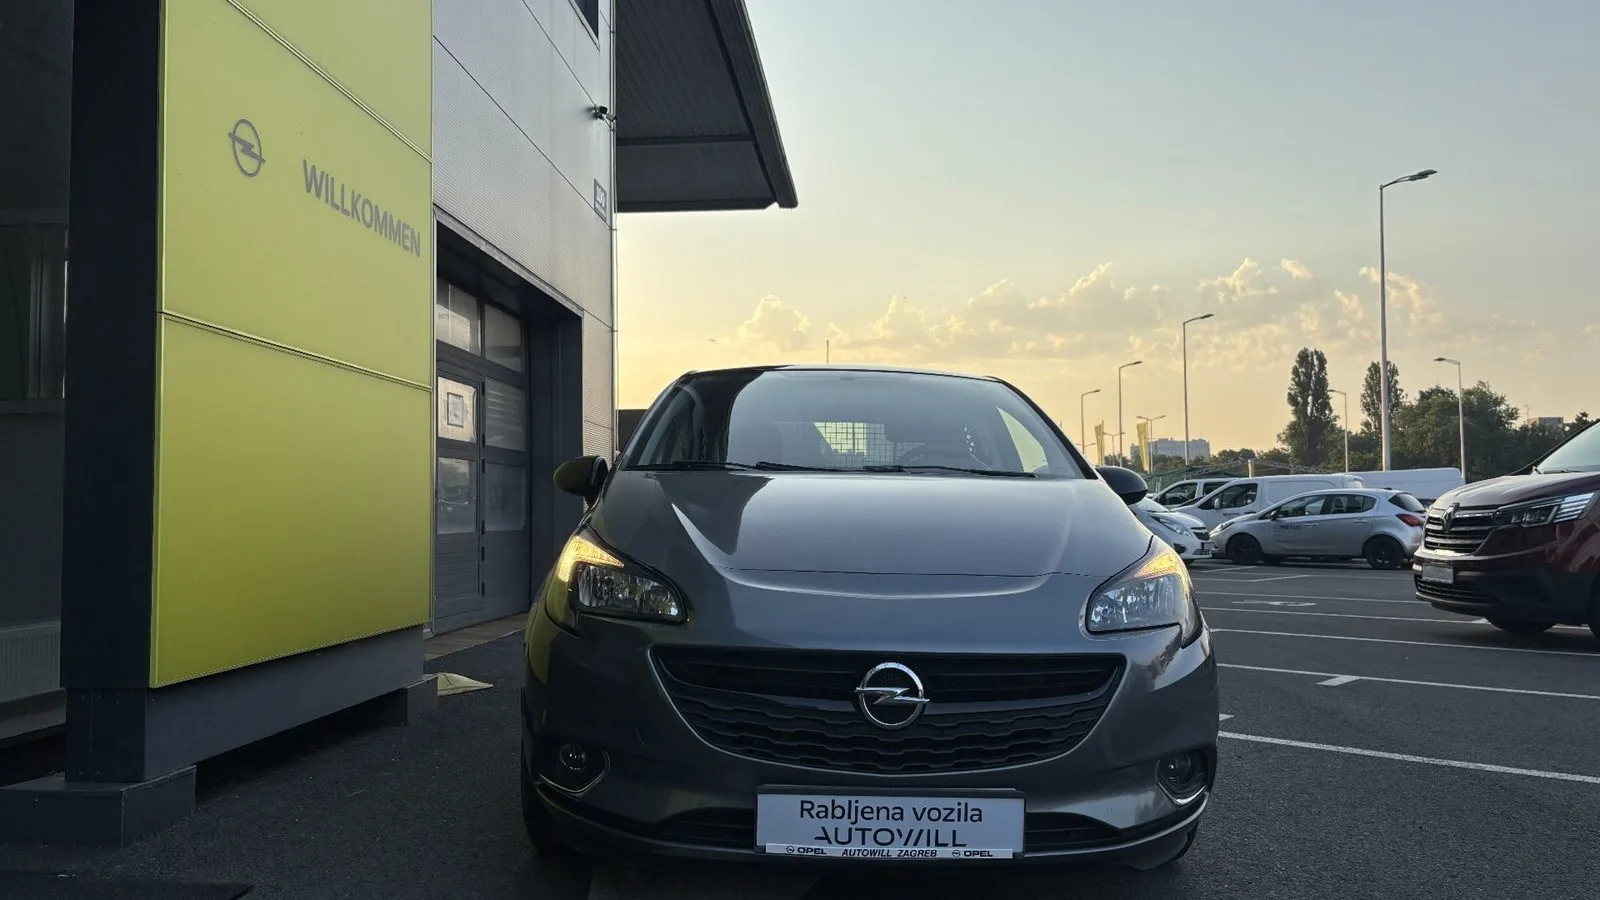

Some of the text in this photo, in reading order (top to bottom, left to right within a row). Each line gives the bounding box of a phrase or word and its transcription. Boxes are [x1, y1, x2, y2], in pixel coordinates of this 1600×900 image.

[303, 158, 420, 258] WILLKOMMEN
[800, 799, 983, 825] Rabljena vozila
[814, 825, 967, 847] AUTOWILL
[797, 846, 993, 858] OPEL AUTOWILL ZAGREB OPEL
